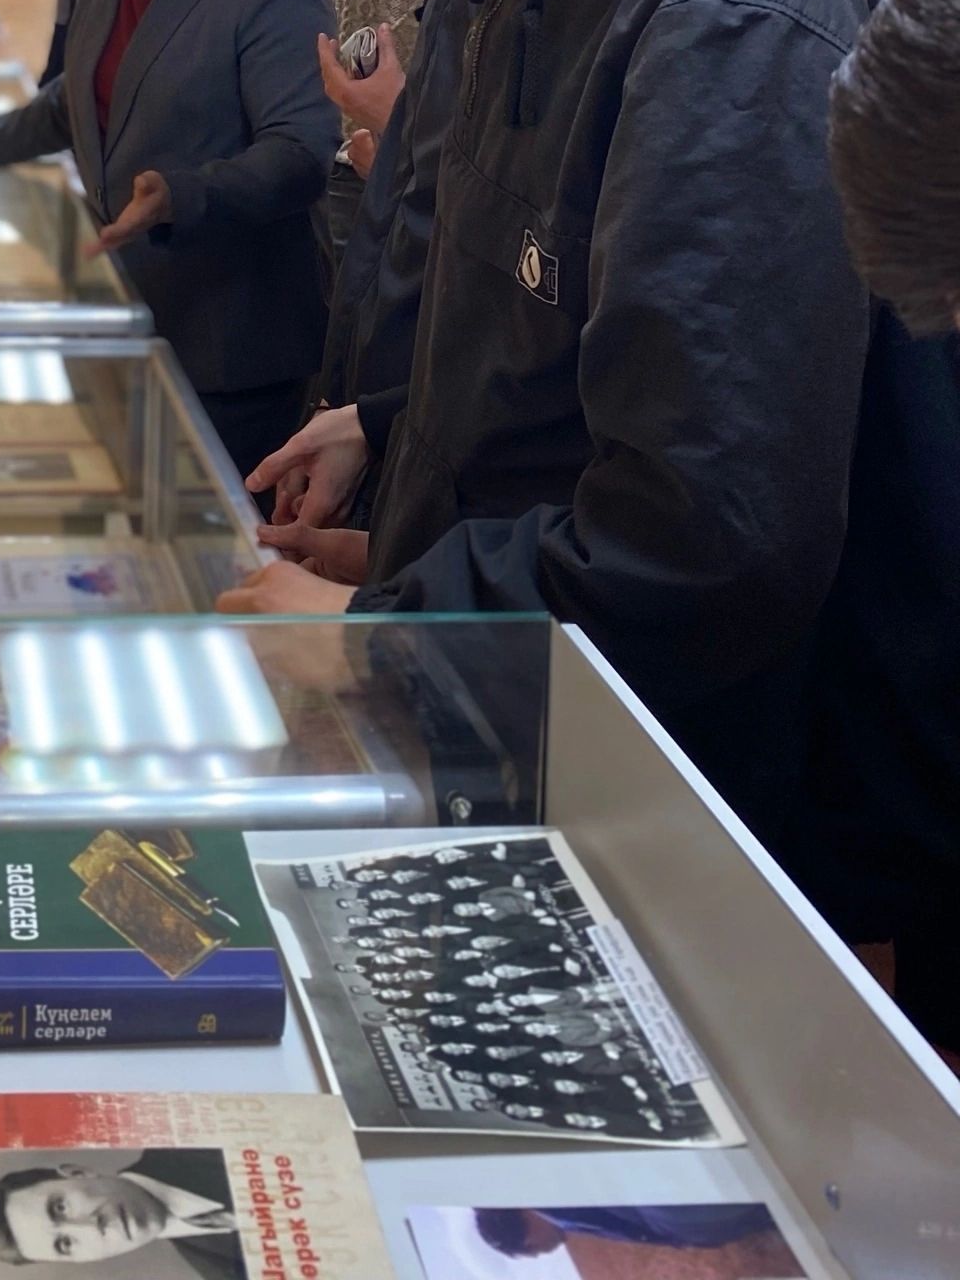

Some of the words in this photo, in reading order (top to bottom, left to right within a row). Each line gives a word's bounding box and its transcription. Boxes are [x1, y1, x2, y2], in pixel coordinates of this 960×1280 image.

[6, 863, 40, 941] СЕРЛӘРЕ
[34, 1004, 113, 1026] Күңелем
[34, 1026, 108, 1041] серләре
[274, 1155, 305, 1210] сүзе
[288, 1218, 322, 1280] өрәк
